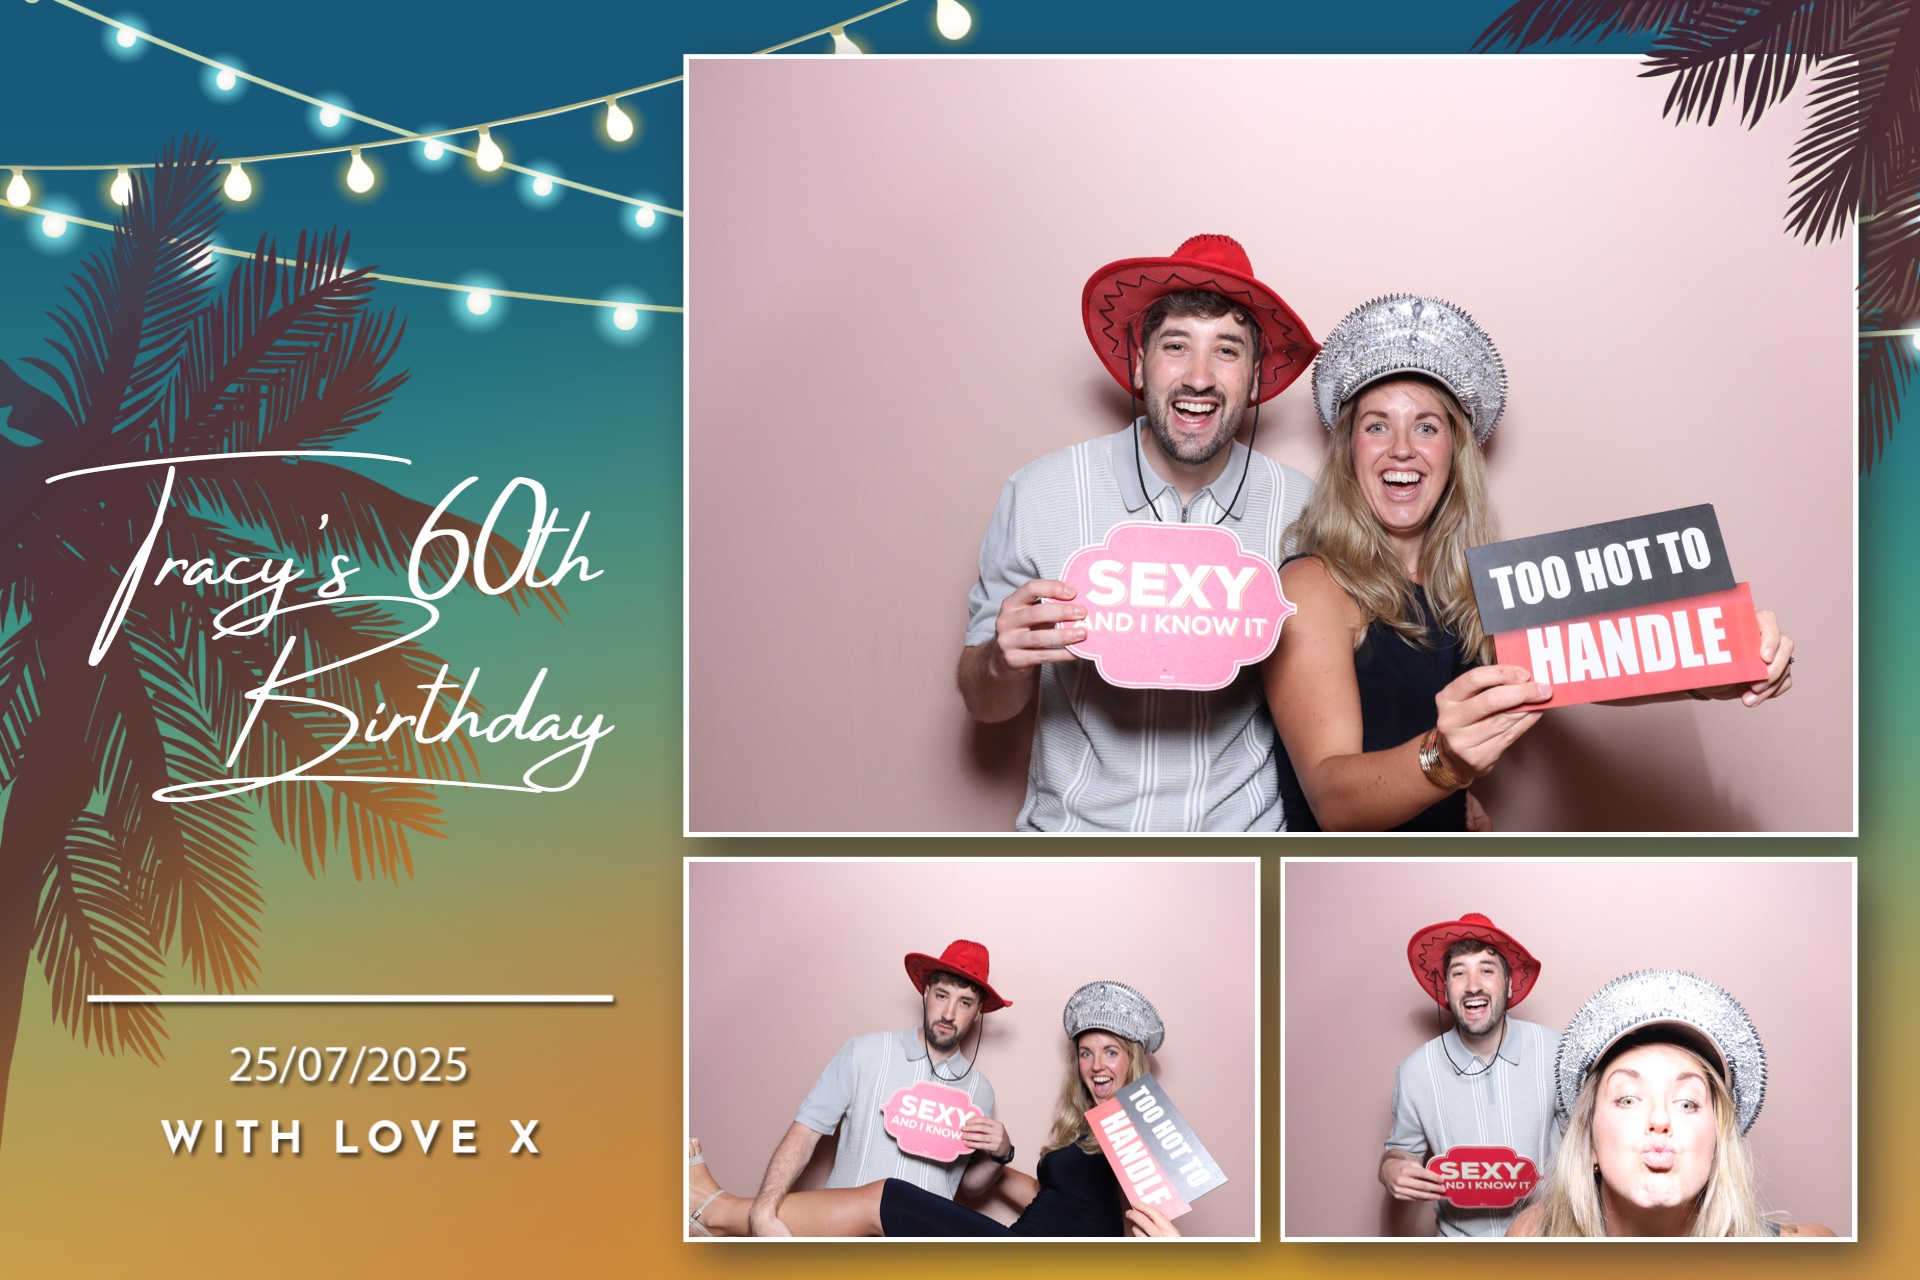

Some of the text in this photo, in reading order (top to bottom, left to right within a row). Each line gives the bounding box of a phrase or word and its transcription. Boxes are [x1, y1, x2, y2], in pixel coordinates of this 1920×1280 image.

[1086, 559, 1259, 611] SEXY
[1489, 527, 1712, 610] TOO HOT TO
[1140, 613, 1148, 634] I
[1154, 614, 1240, 637] KNOW
[1245, 618, 1268, 638] IT
[1526, 606, 1733, 686] HANDLE
[890, 1114, 963, 1141] AND I KNOW
[899, 1094, 976, 1129] SEXY
[1099, 1109, 1173, 1206] HANDLE
[1128, 1084, 1211, 1188] TOO HOT TO
[1440, 1161, 1526, 1180] SEXY
[1445, 1181, 1531, 1190] ND I KNOW IT
